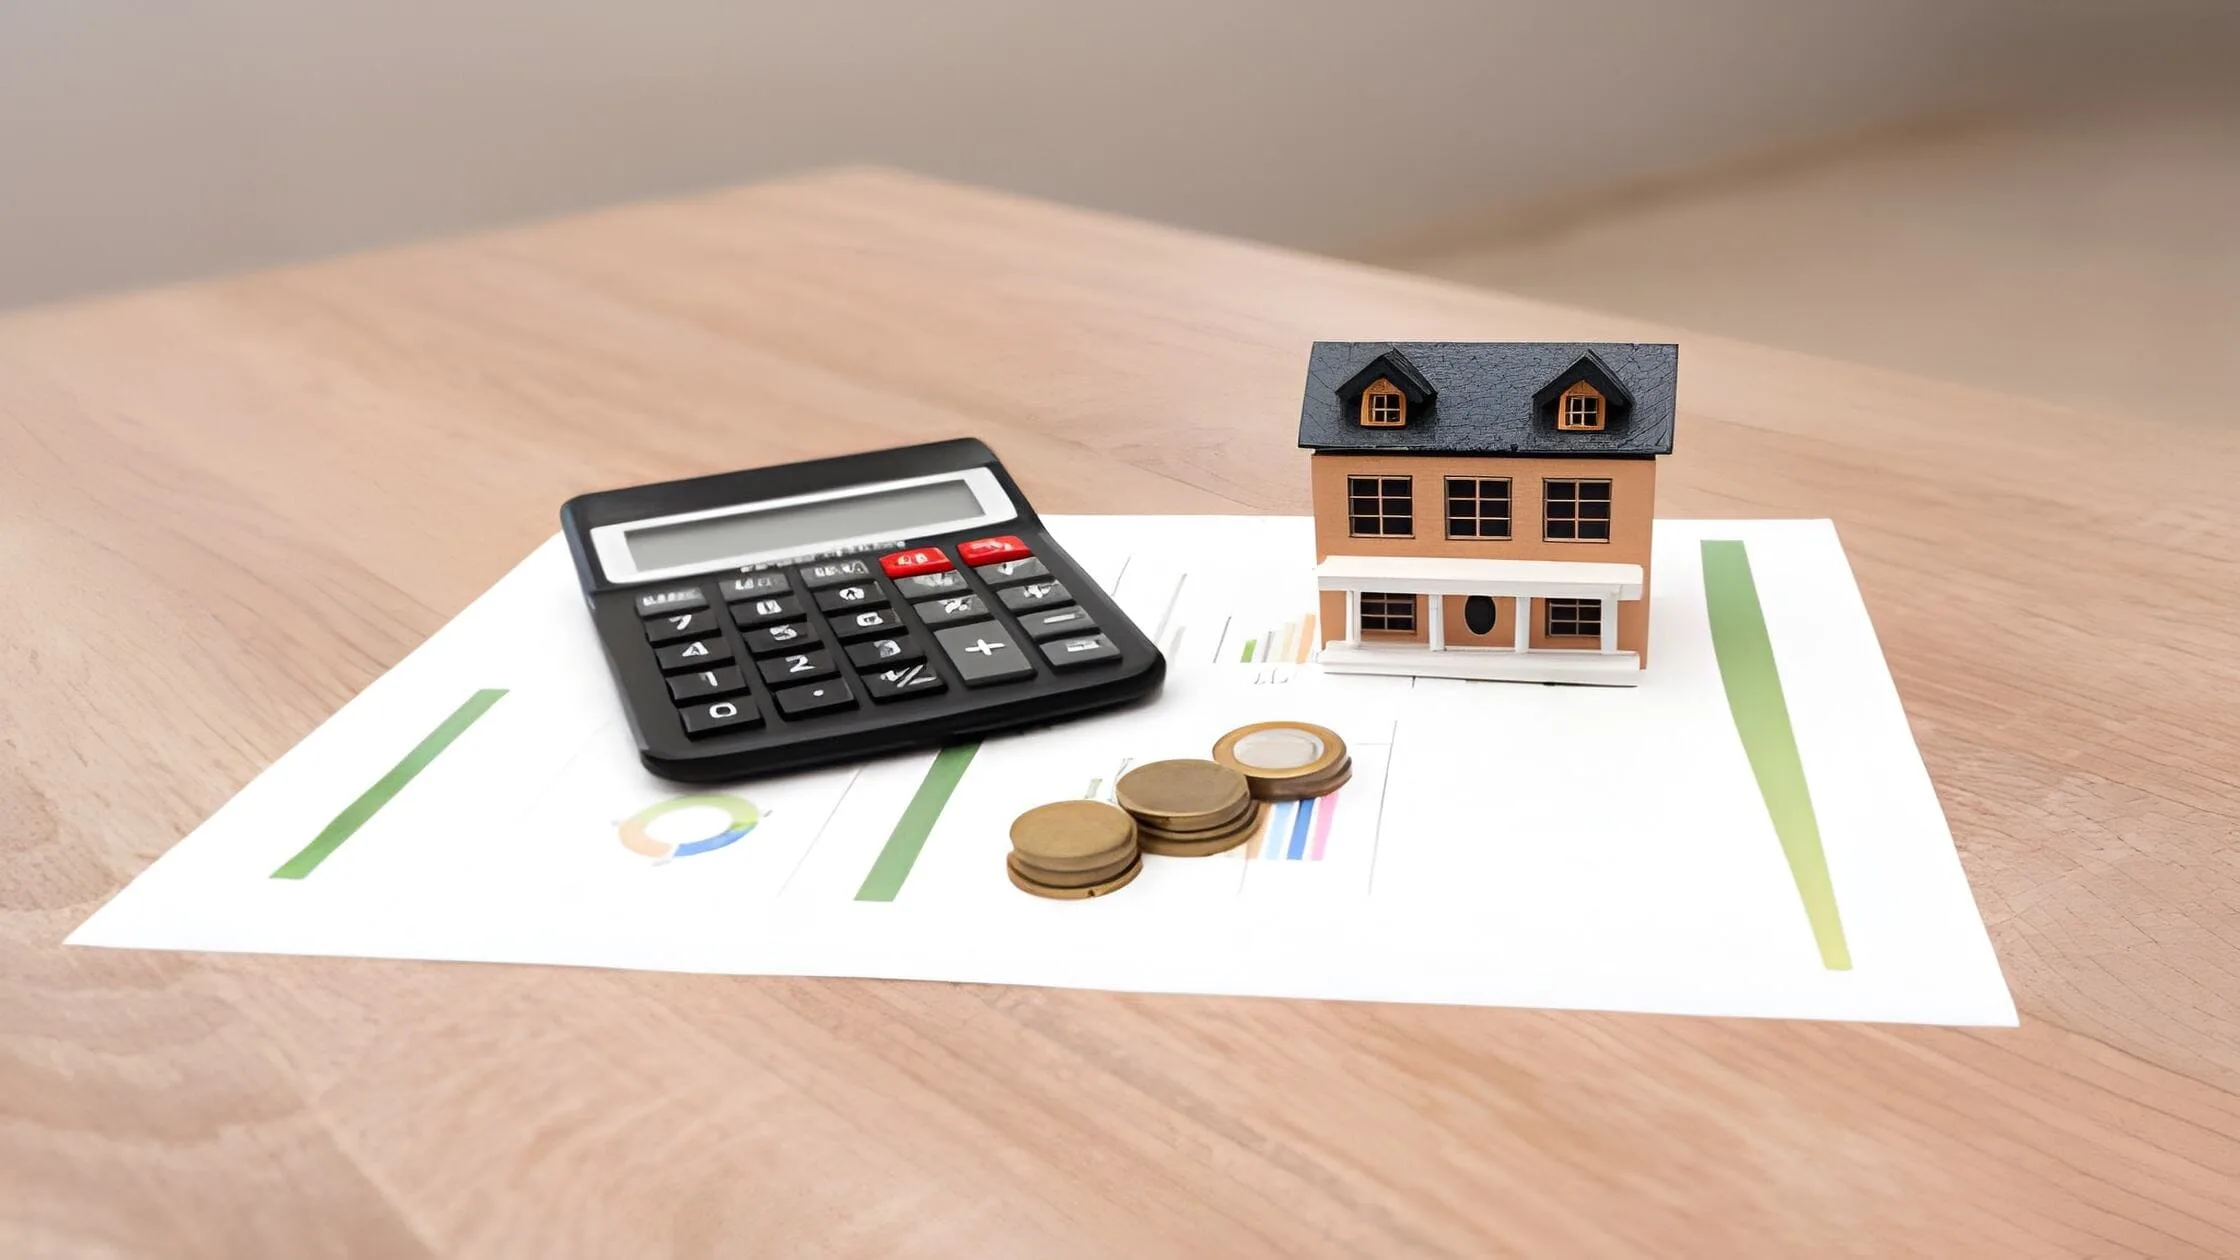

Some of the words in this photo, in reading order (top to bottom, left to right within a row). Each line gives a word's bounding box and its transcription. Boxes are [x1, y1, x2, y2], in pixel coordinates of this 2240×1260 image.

[668, 614, 692, 630] 7
[785, 655, 815, 673] 2
[709, 702, 737, 718] 0
